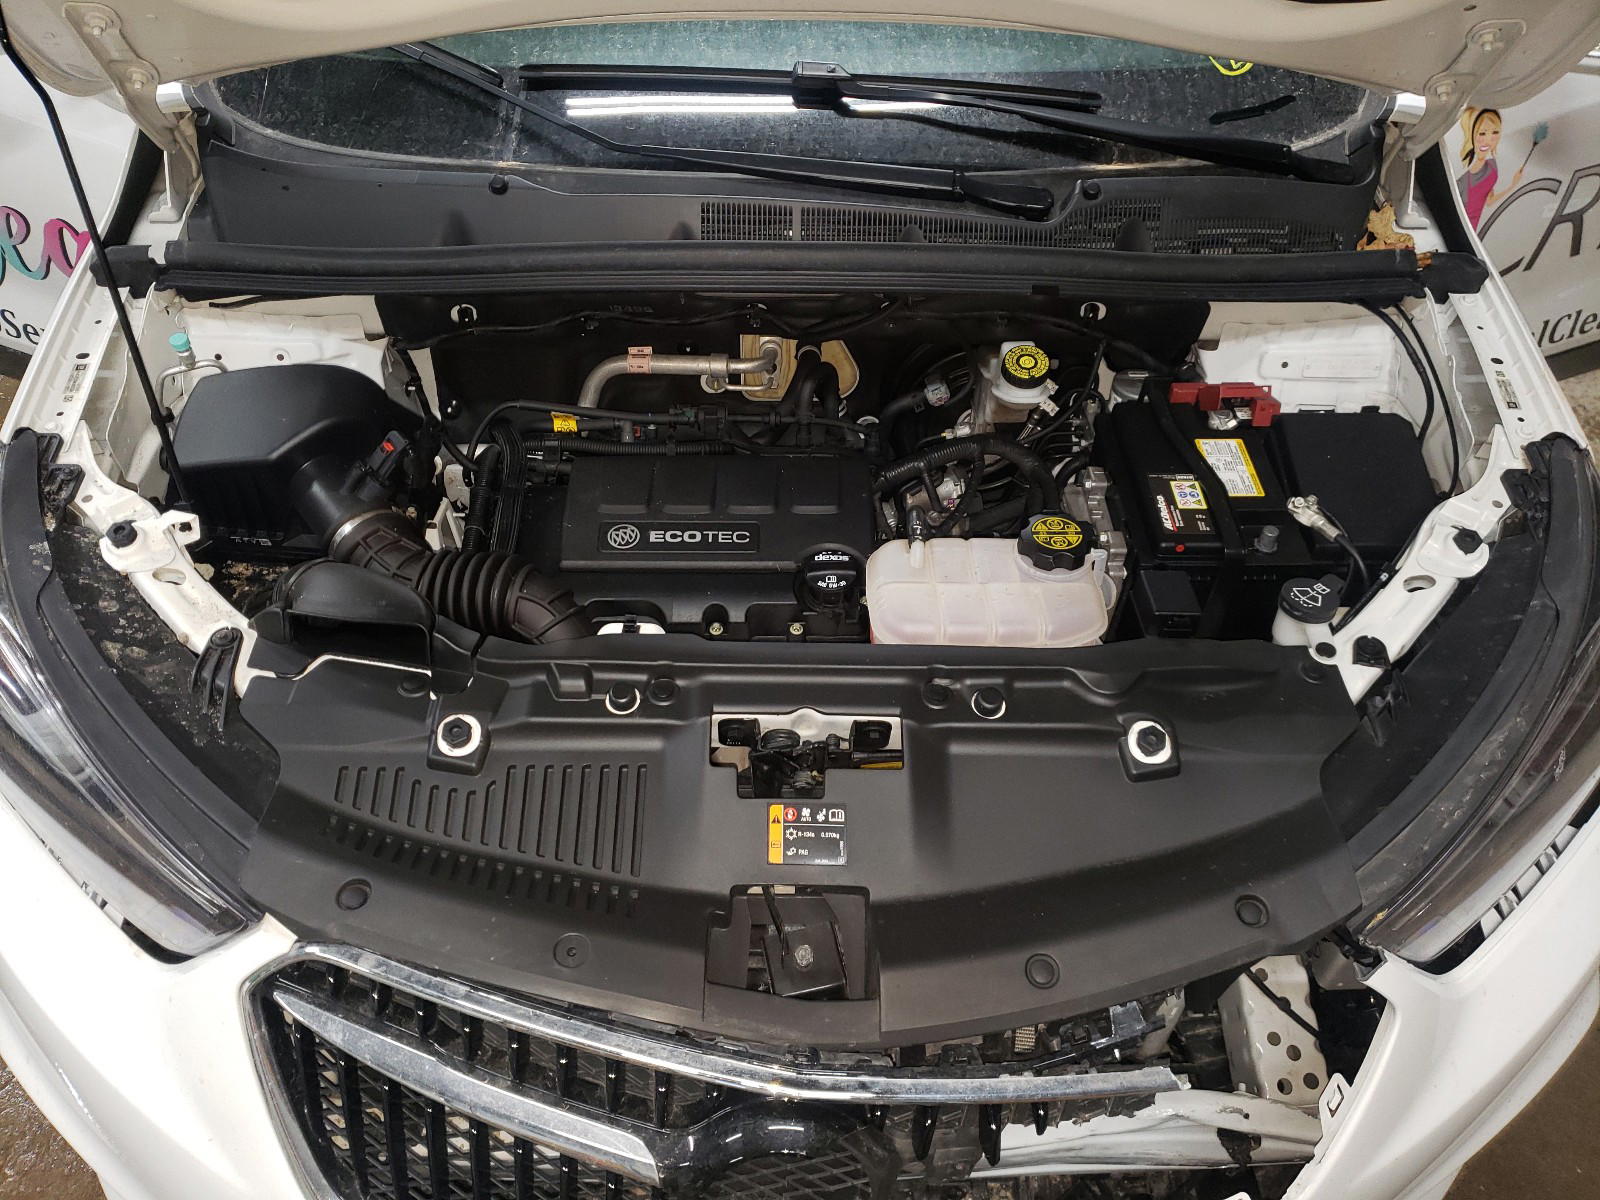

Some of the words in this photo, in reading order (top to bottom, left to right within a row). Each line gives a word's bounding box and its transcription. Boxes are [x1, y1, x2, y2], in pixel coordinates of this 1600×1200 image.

[1477, 163, 1600, 276] CR
[0, 309, 45, 345] Se
[1531, 309, 1600, 348] lCle
[649, 530, 751, 543] ECOTEC
[814, 553, 850, 562] dexos
